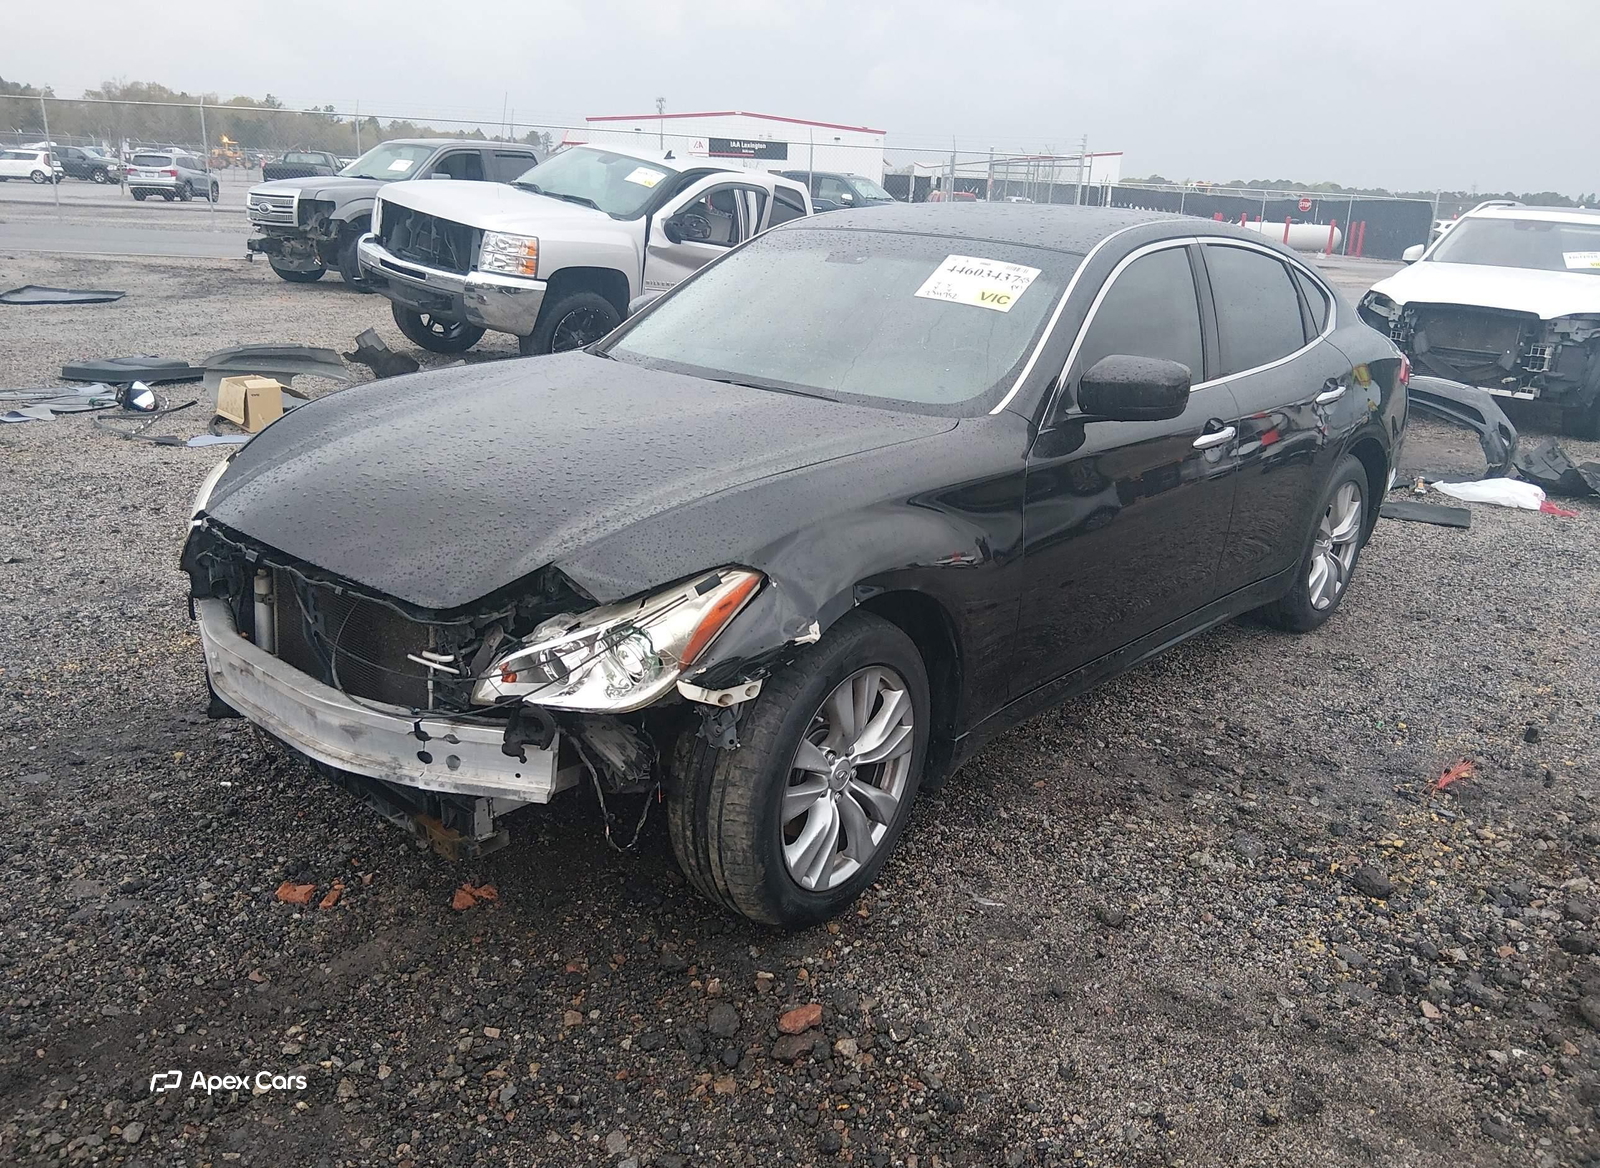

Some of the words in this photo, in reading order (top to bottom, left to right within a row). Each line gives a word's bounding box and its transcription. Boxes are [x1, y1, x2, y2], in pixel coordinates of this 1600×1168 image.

[730, 140, 741, 148] IAA
[741, 141, 767, 150] Lexington
[980, 291, 1011, 304] VIC
